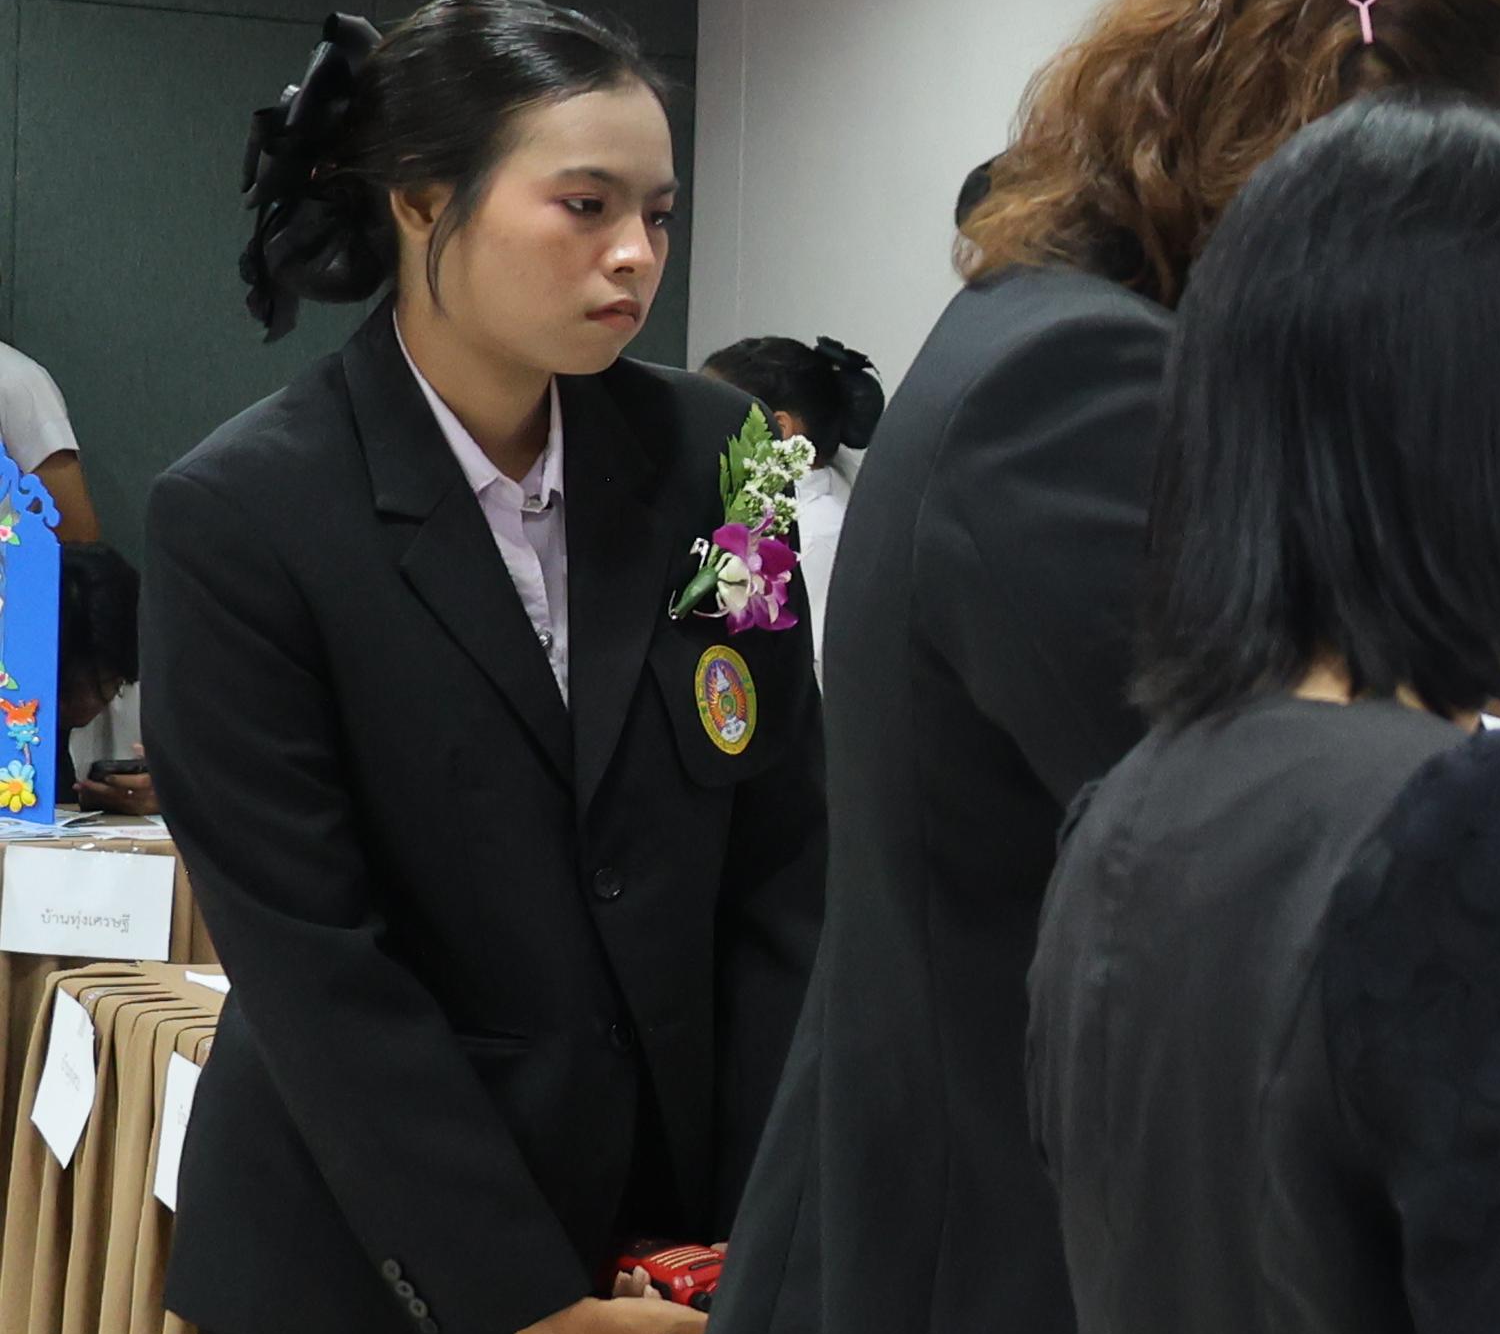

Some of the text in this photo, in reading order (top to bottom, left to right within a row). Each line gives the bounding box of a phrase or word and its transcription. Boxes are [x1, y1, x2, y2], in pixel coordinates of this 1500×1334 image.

[41, 908, 129, 933] บ้านทุ่งเศรษฐี
